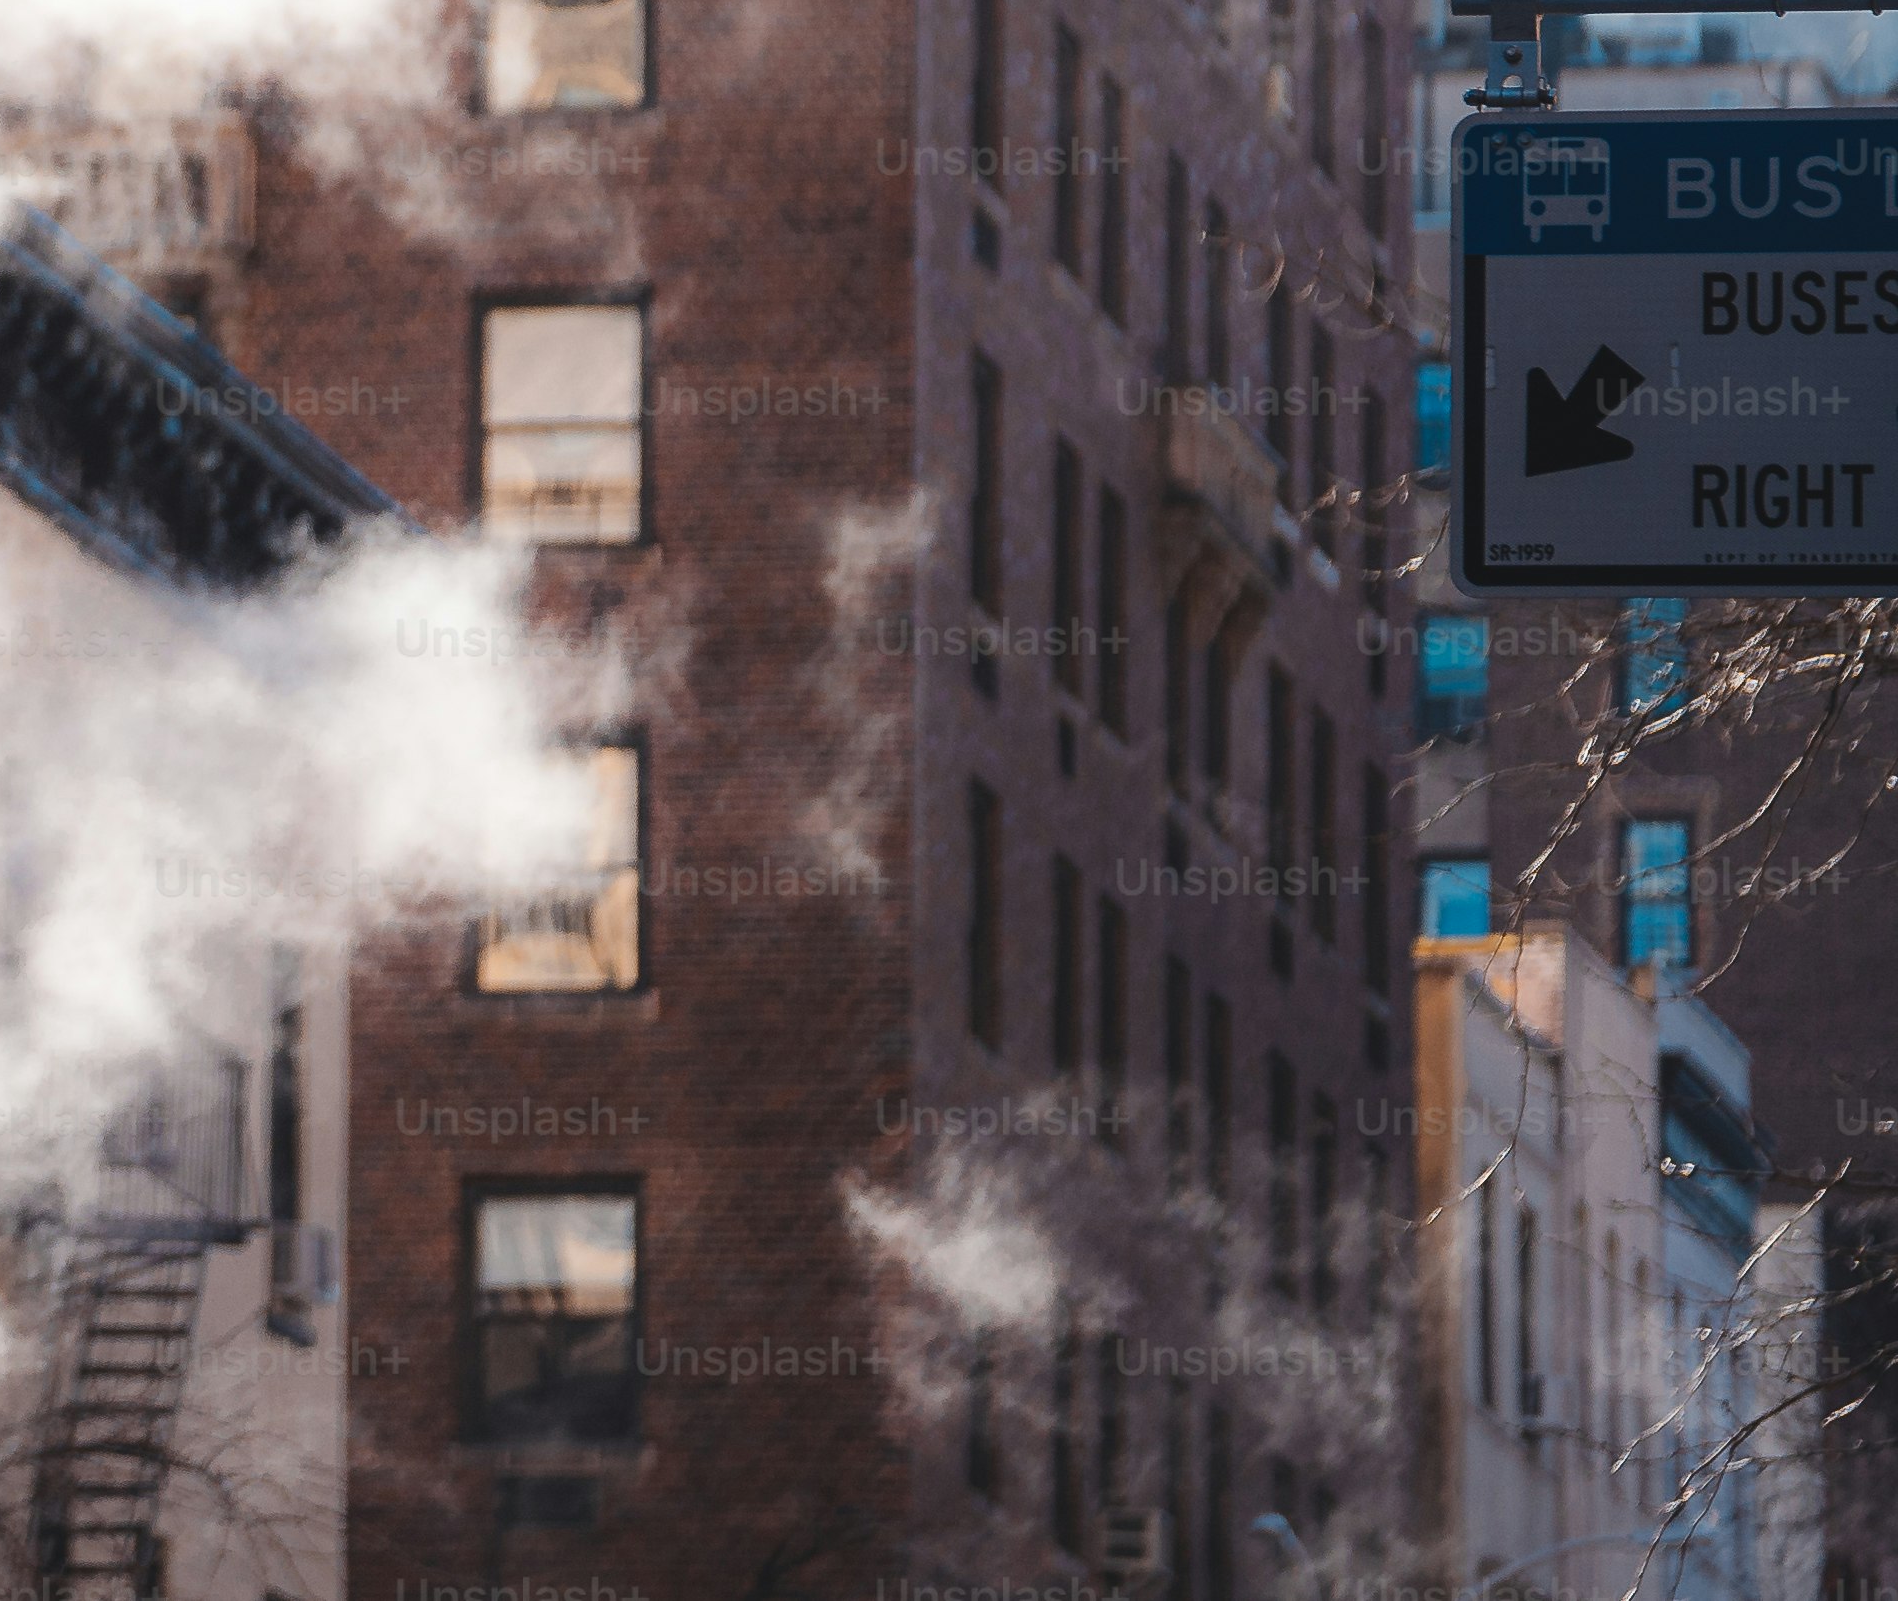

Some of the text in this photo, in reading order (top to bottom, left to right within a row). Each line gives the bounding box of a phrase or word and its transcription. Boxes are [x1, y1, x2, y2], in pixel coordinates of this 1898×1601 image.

[1667, 156, 1842, 219] BUS
[1703, 270, 1898, 335] BUSES
[1692, 464, 1874, 528] RIGHT
[1489, 543, 1555, 561] SR-1959
[1705, 553, 1746, 563] DEPT
[1758, 553, 1778, 563] OF
